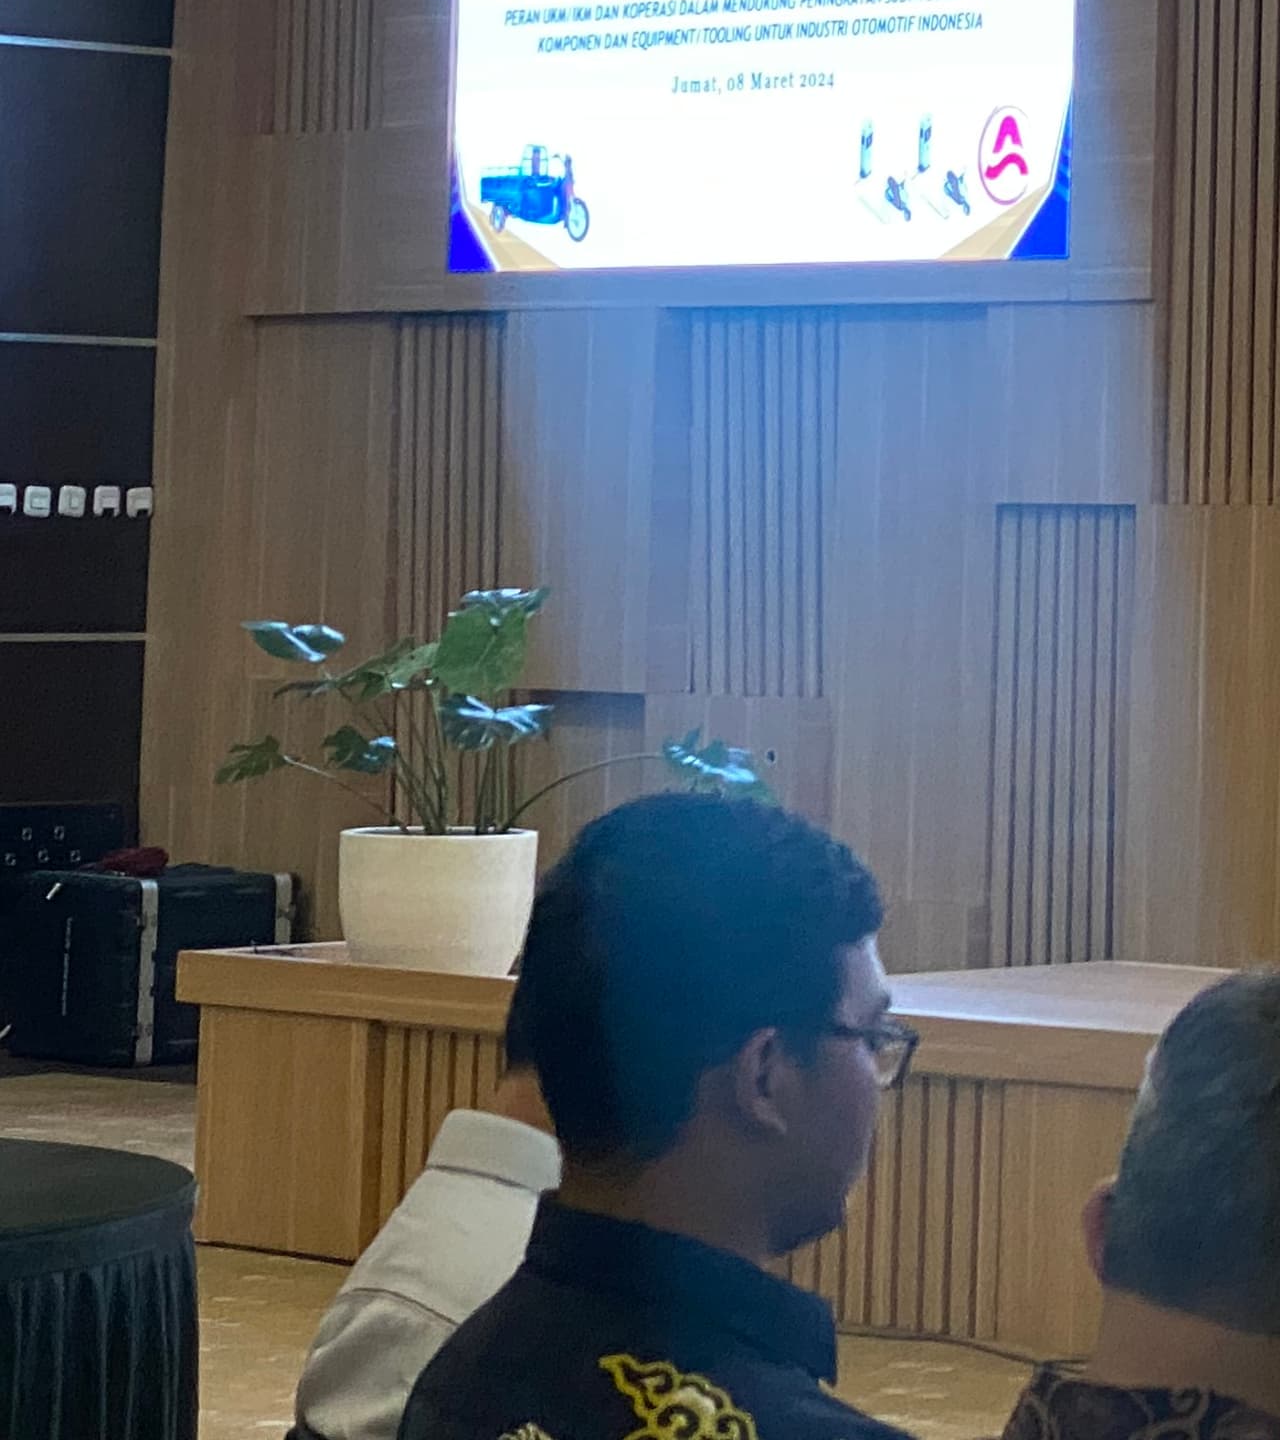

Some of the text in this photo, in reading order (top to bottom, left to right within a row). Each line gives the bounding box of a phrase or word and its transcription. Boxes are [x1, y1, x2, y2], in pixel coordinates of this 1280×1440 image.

[504, 9, 540, 26] PERAN
[595, 5, 619, 21] DAN
[622, 0, 677, 19] KOPERASI
[537, 34, 601, 53] KOMPONEN
[604, 33, 628, 50] DAN
[755, 23, 793, 41] UNTUK
[796, 19, 847, 38] INDUSTRI
[852, 15, 915, 37] OTOMOTIF
[918, 12, 983, 32] INDONESIA
[751, 72, 794, 90] Maret
[799, 72, 834, 88] 2024
